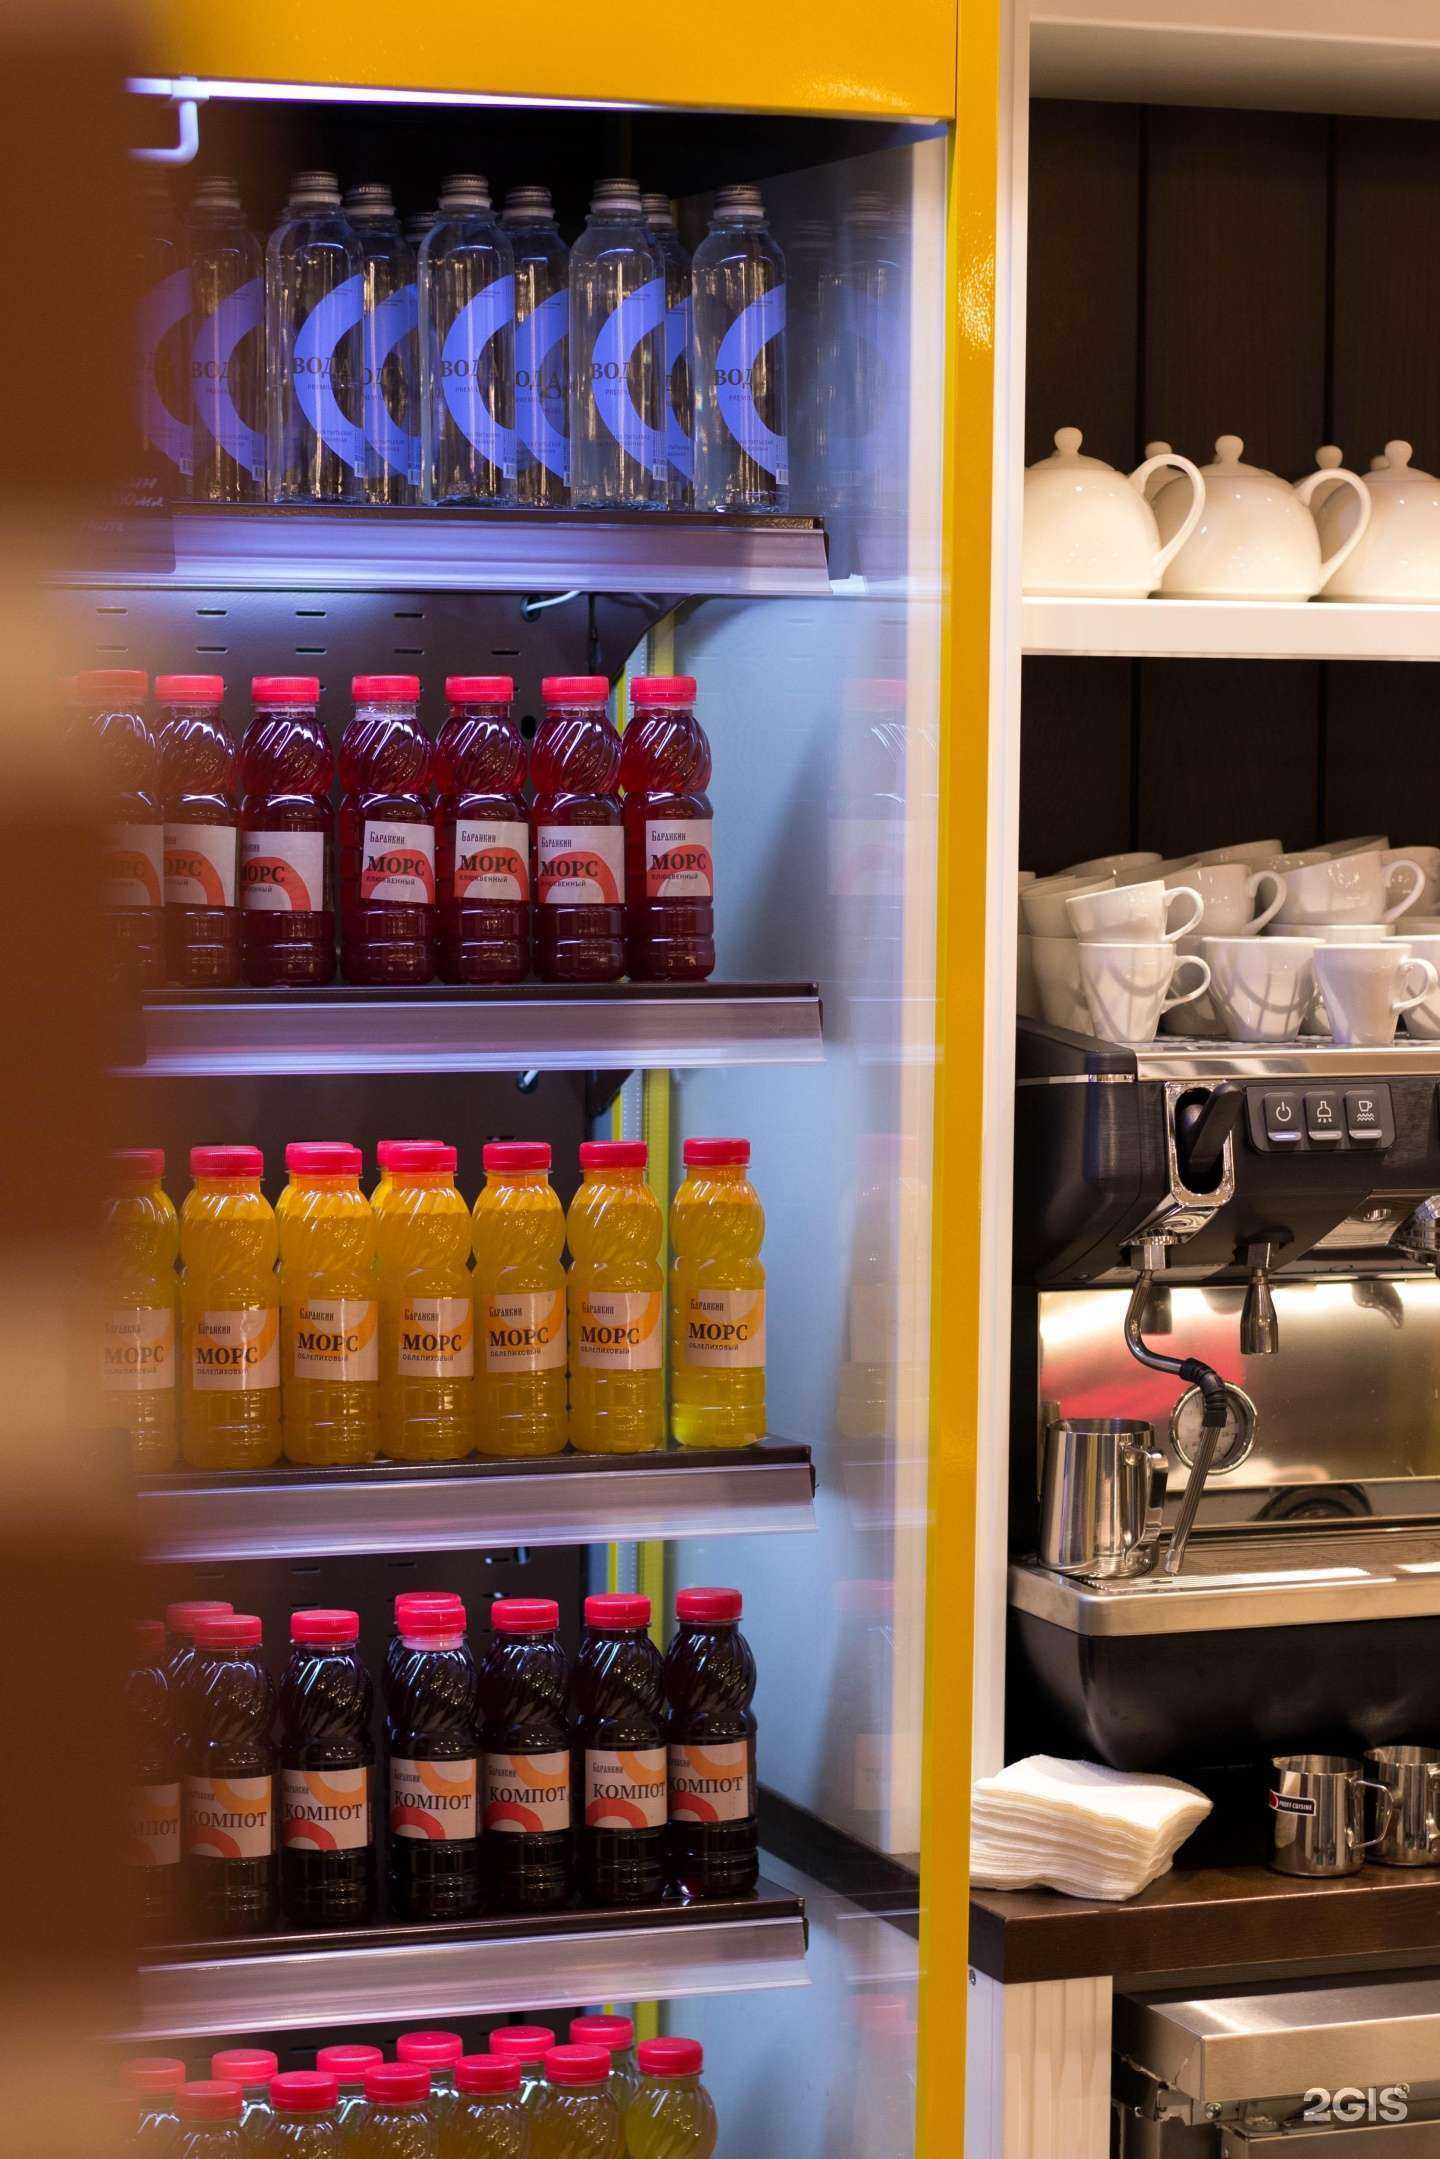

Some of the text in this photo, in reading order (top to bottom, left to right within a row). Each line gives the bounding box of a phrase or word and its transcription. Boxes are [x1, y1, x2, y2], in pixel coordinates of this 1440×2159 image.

[164, 859, 202, 878] ОРС
[366, 855, 425, 876] МОРС
[458, 854, 518, 874] МОРС
[540, 860, 599, 877] МОРС
[650, 854, 708, 872] МОРС
[488, 1327, 550, 1347] МОРС
[580, 1326, 640, 1345] МОРС
[688, 1323, 748, 1341] МОРС
[298, 1332, 358, 1352] МОРС
[402, 1333, 462, 1352] МОРС
[197, 1346, 258, 1364] МОРС
[394, 1790, 472, 1810] КОМПОТ
[489, 1786, 566, 1803] КОМПОТ
[592, 1783, 665, 1799] КОМПОТ
[189, 1811, 267, 1828] КОМПОТ
[285, 1804, 362, 1821] КОМПОТ
